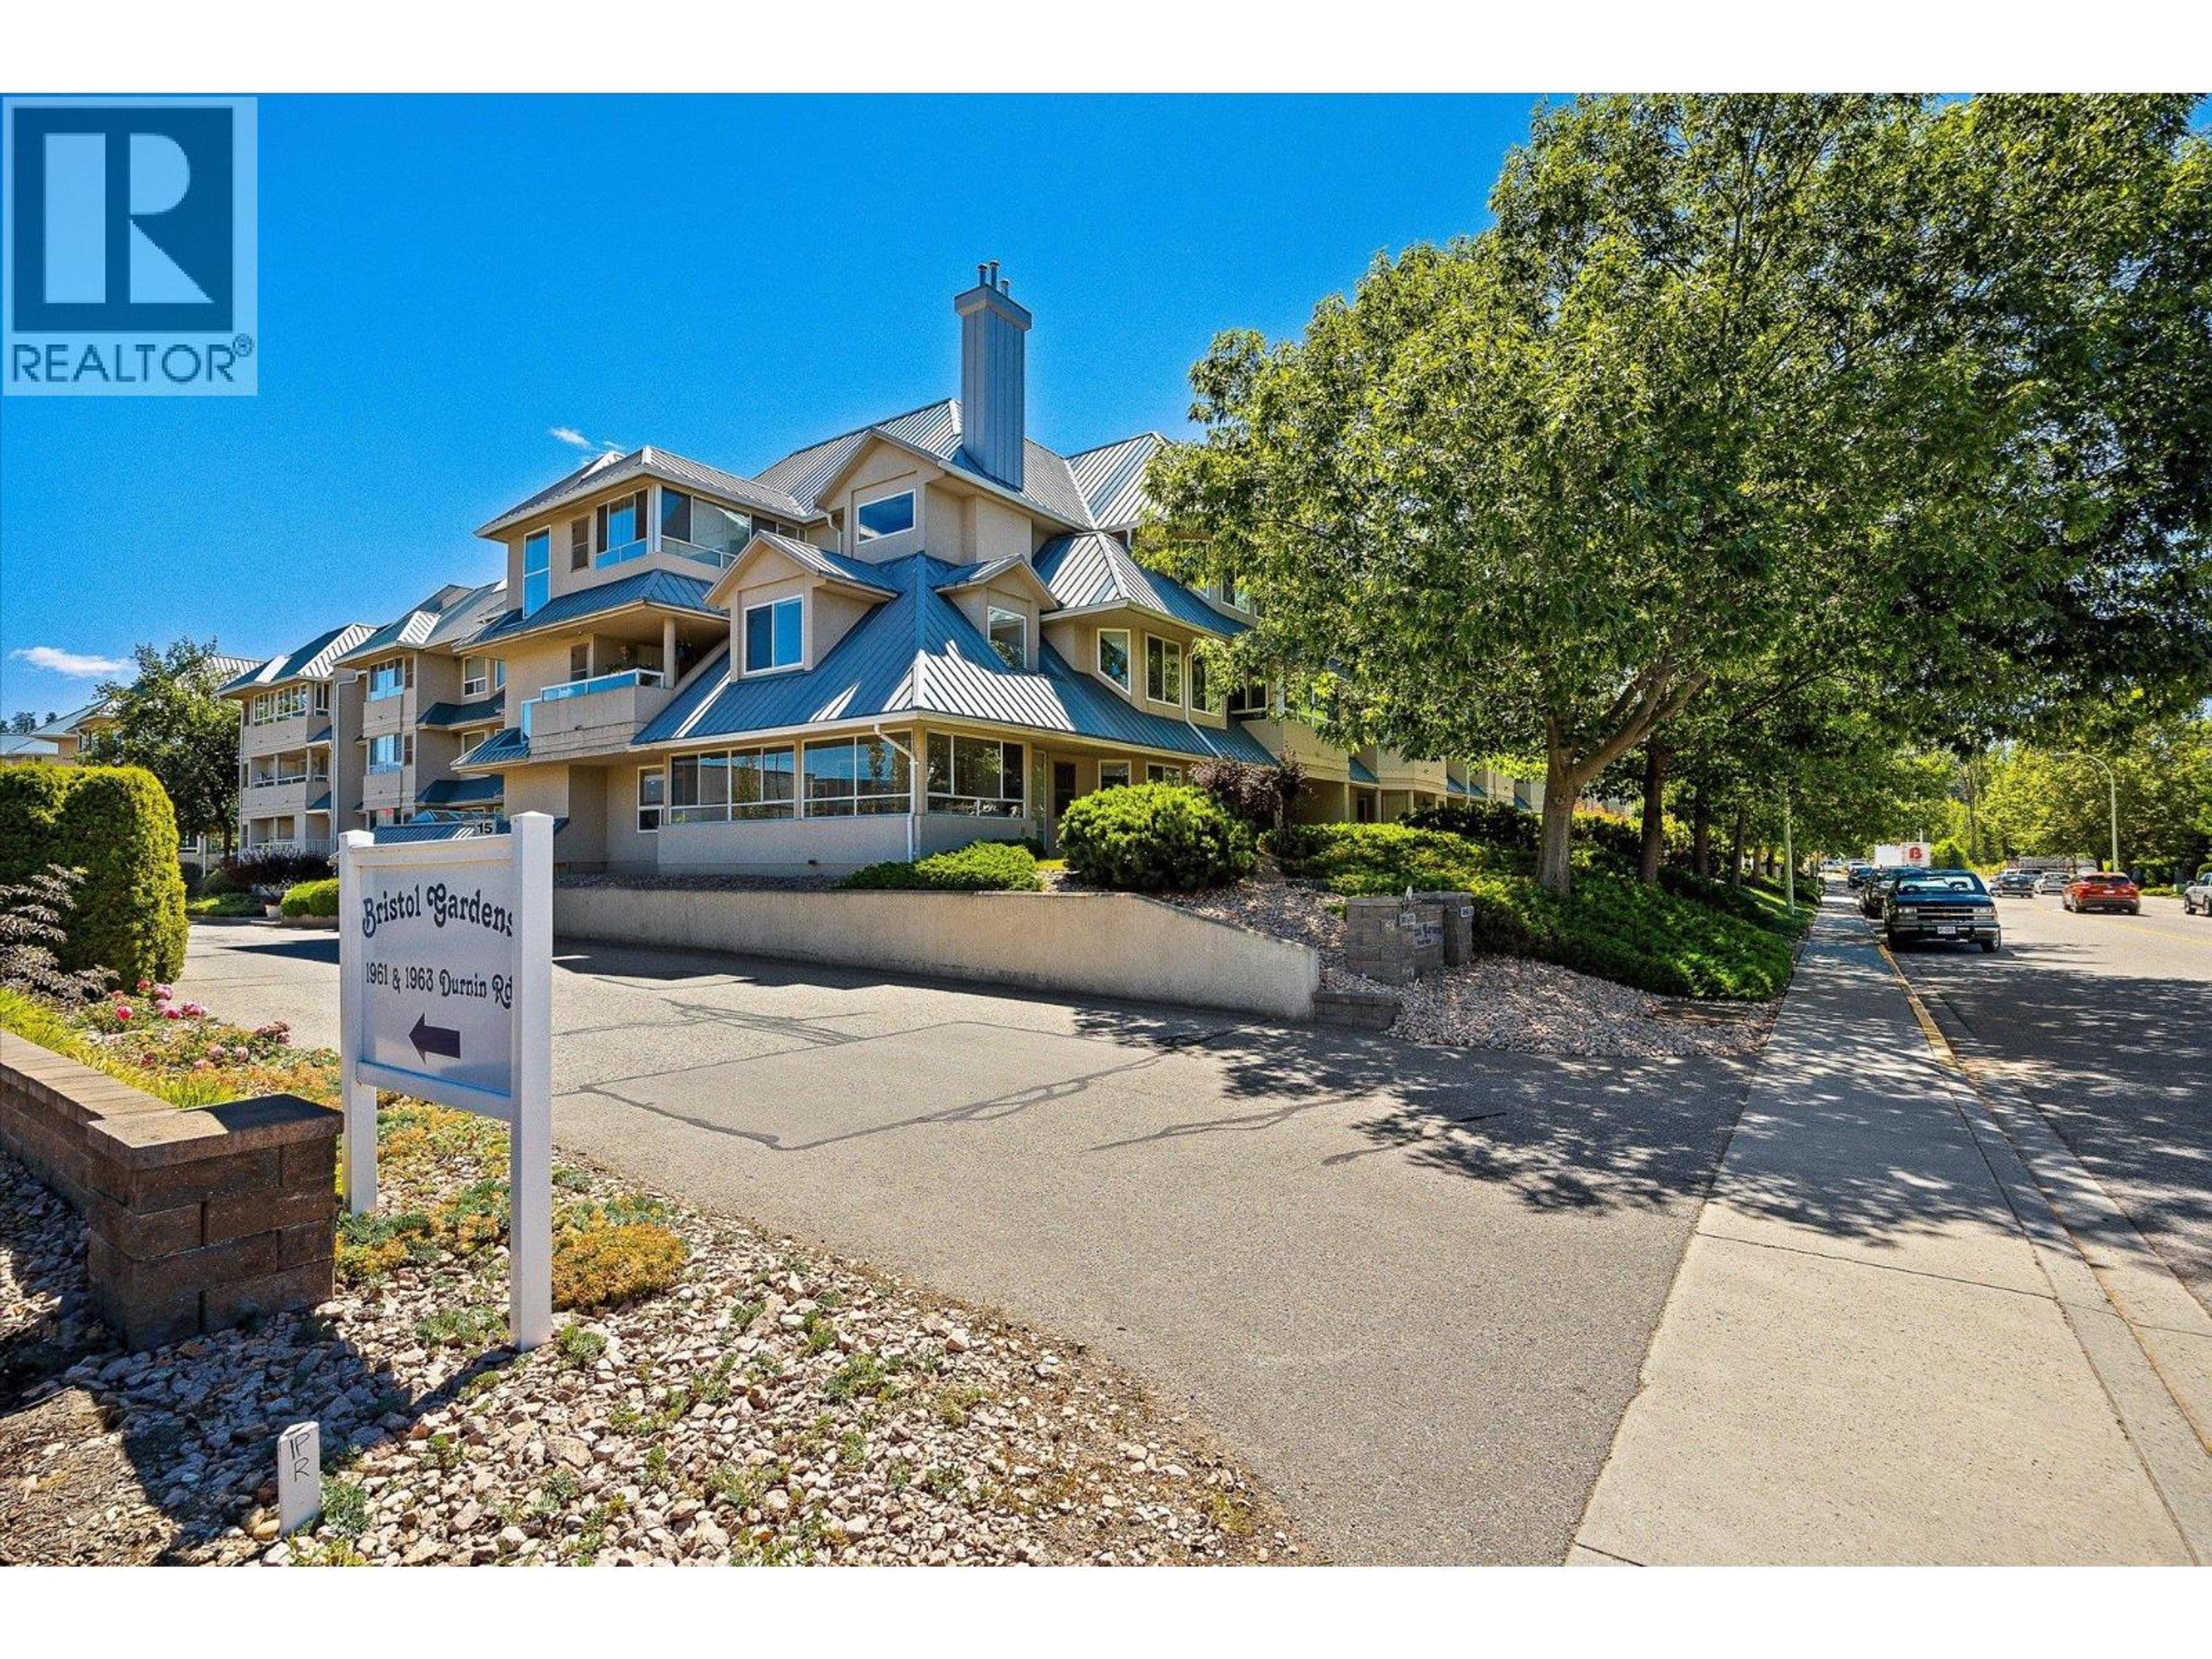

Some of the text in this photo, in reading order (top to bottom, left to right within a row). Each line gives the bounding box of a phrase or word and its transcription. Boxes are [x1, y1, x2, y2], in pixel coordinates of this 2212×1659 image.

[478, 823, 493, 834] 15
[362, 884, 421, 938] Bristol
[366, 962, 388, 986] 1961
[392, 967, 401, 995] &
[406, 966, 433, 992] 1963
[439, 969, 487, 999] Durnin
[294, 1457, 309, 1482] R
